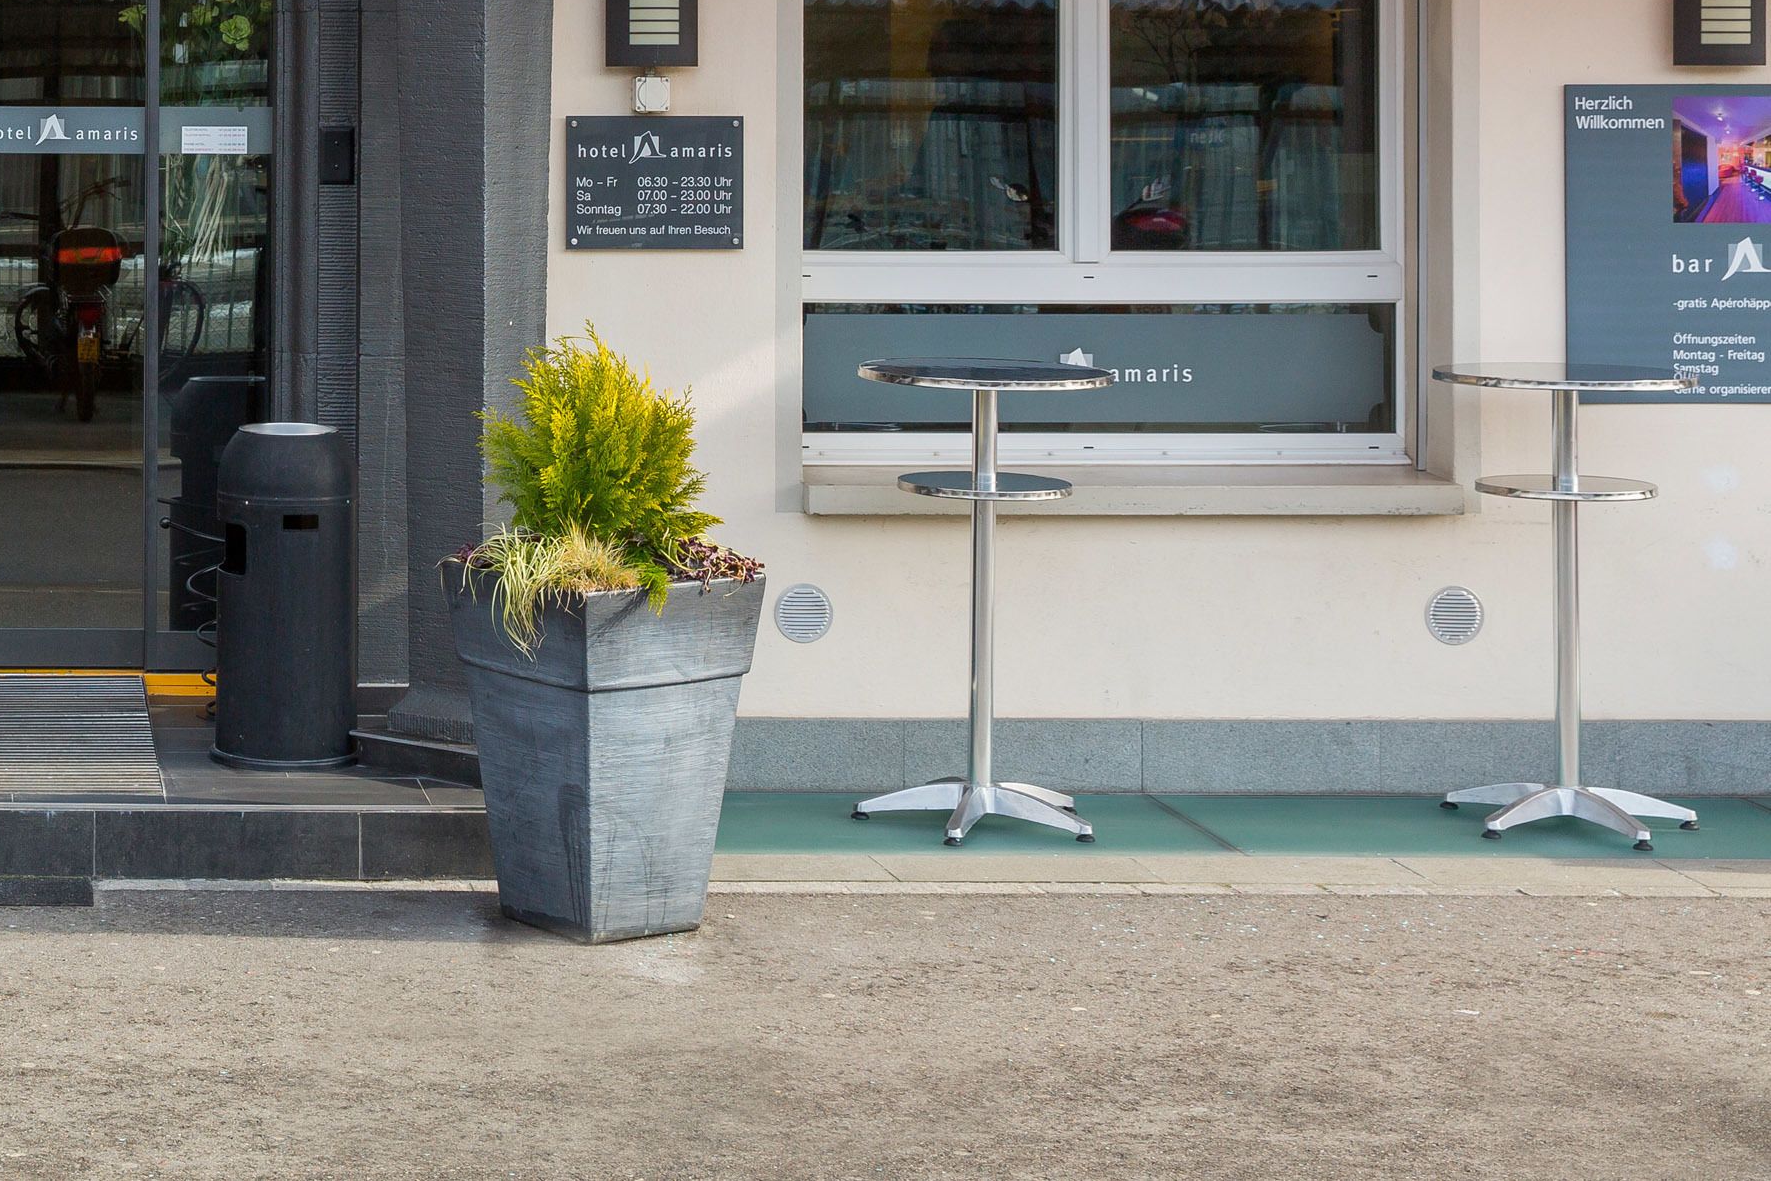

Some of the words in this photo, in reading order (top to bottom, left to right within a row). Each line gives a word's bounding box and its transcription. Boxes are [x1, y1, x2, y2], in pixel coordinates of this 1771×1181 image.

[1575, 96, 1633, 110] Herzlich
[1576, 115, 1664, 130] Willkommen
[76, 127, 138, 140] amaris
[578, 144, 626, 158] hotel
[670, 144, 733, 157] amaris
[576, 177, 593, 187] Mo
[607, 177, 617, 187] Fr
[637, 177, 667, 187] 06.30
[681, 177, 711, 187] 23.30
[714, 177, 732, 187] Uhr
[576, 191, 591, 201] Sa
[637, 190, 667, 200] 07.00
[681, 190, 711, 200] 23.00
[714, 190, 732, 200] Uhr
[576, 204, 622, 217] Sonntag
[637, 204, 667, 214] 07.30
[681, 204, 711, 214] 22.00
[714, 204, 732, 214] Uhr
[577, 226, 592, 235] Wir
[596, 226, 626, 235] freuen
[650, 226, 665, 235] auf
[668, 226, 691, 235] Ihren
[694, 226, 730, 235] Besuch
[1672, 254, 1713, 273] bar
[1673, 298, 1707, 310] -gratis
[1711, 298, 1771, 310] Apérohäpp
[1673, 333, 1756, 346] Öffnungszeiten
[1673, 350, 1715, 362] Montag
[1728, 349, 1765, 362] Freitag
[1112, 364, 1192, 382] amaris
[1673, 364, 1719, 375] Samstag
